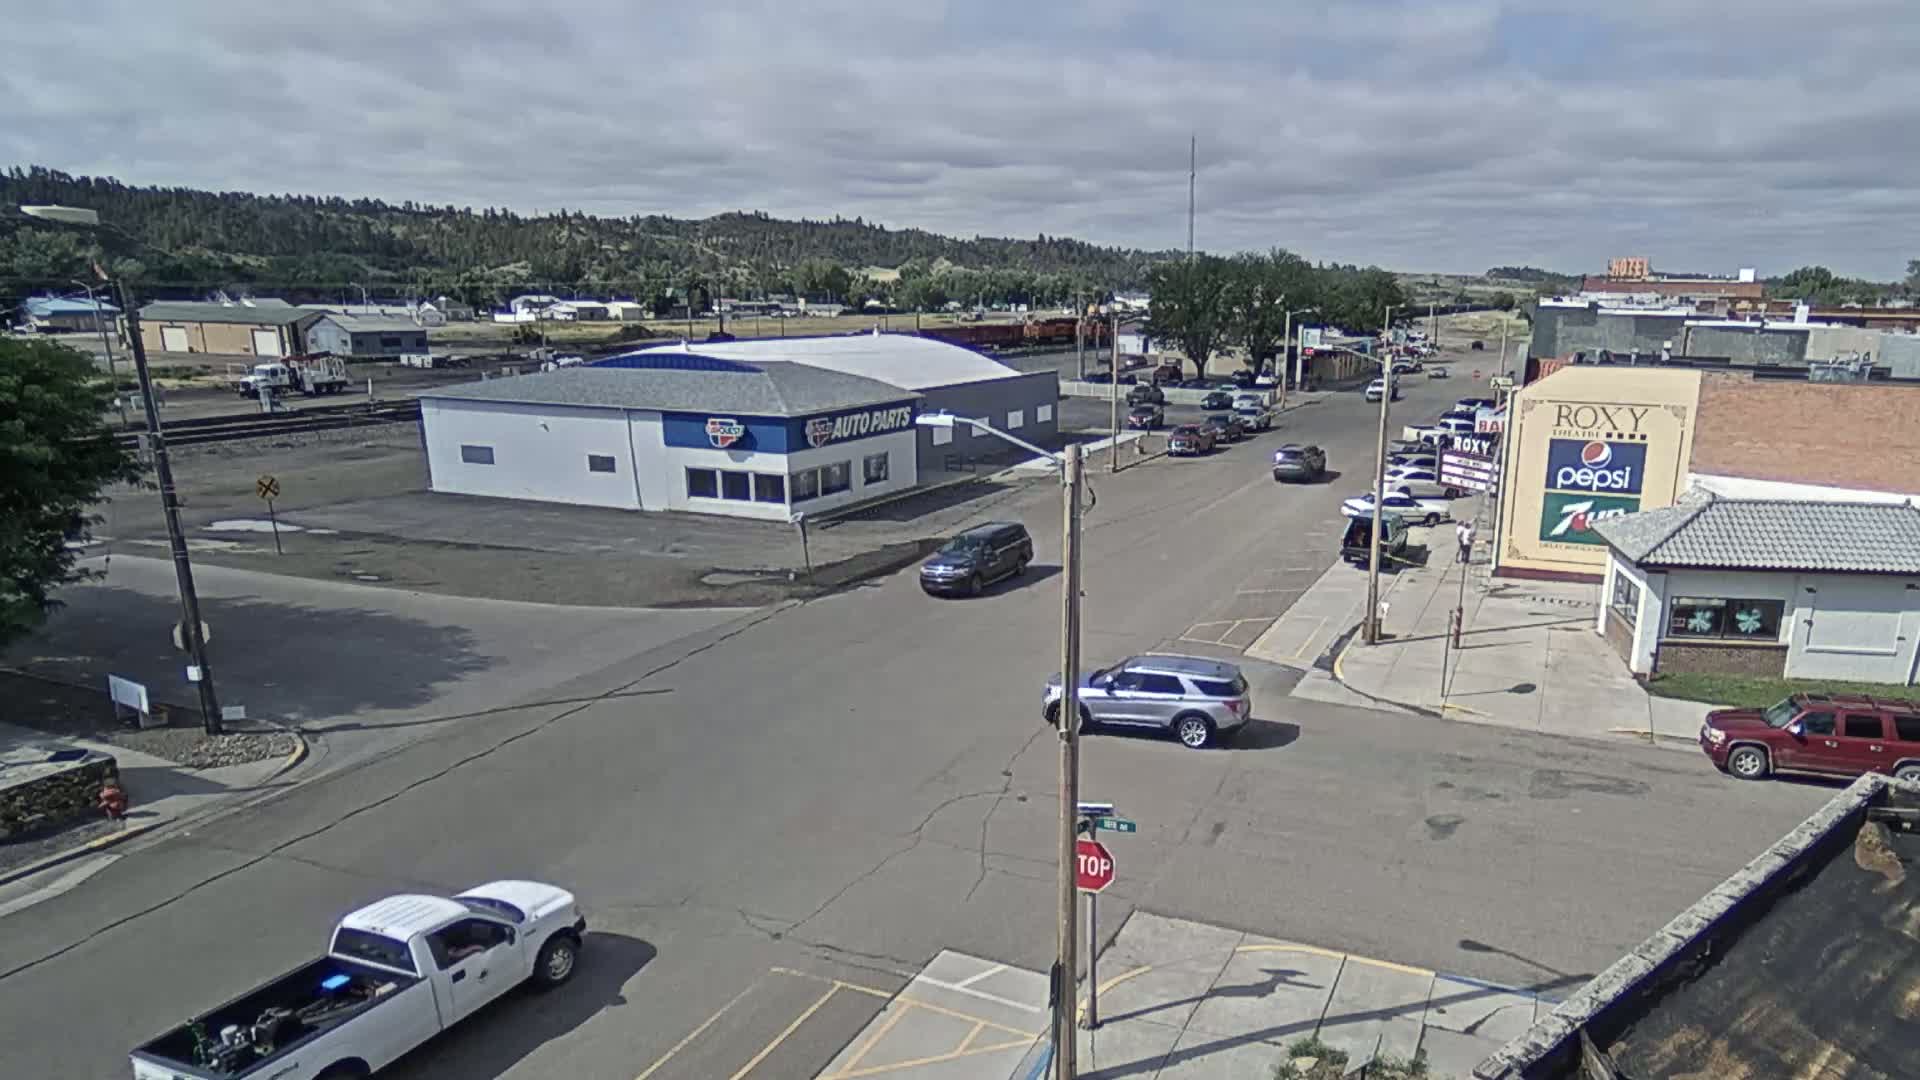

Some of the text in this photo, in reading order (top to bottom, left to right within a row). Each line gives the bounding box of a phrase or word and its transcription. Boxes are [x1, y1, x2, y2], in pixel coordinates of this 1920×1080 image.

[831, 412, 870, 439] AUTO
[870, 406, 911, 432] PARTS
[1552, 405, 1648, 431] ROXY
[1453, 435, 1491, 456] ROXY
[1557, 466, 1631, 491] pepsi
[1078, 854, 1111, 877] TOP
